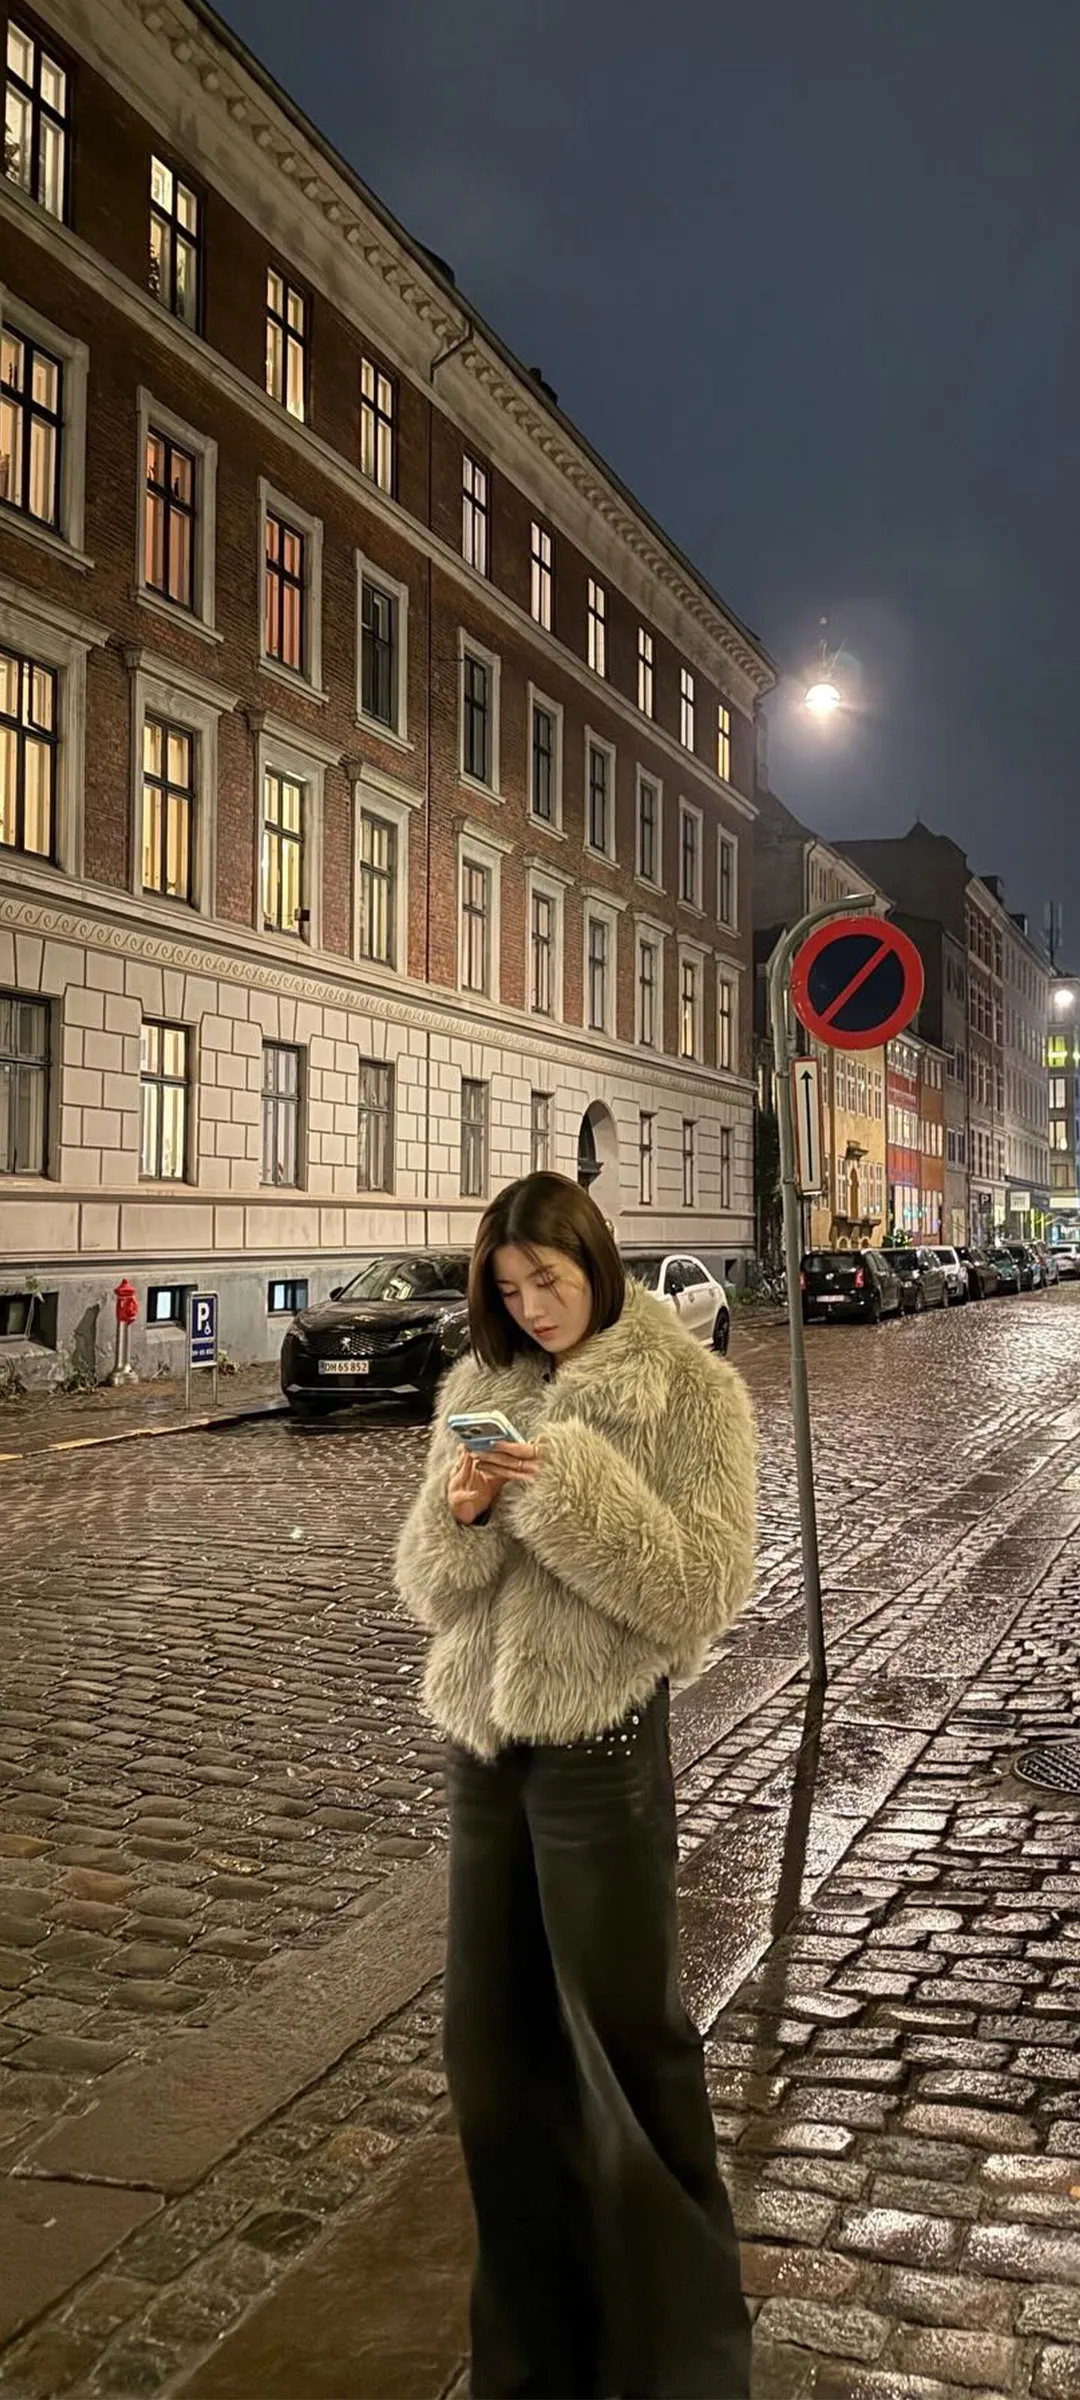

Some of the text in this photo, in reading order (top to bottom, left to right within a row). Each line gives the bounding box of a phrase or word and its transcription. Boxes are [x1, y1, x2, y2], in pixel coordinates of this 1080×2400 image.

[981, 1194, 989, 1205] P
[197, 1302, 210, 1331] P
[338, 1362, 349, 1372] 65
[350, 1362, 367, 1372] 852
